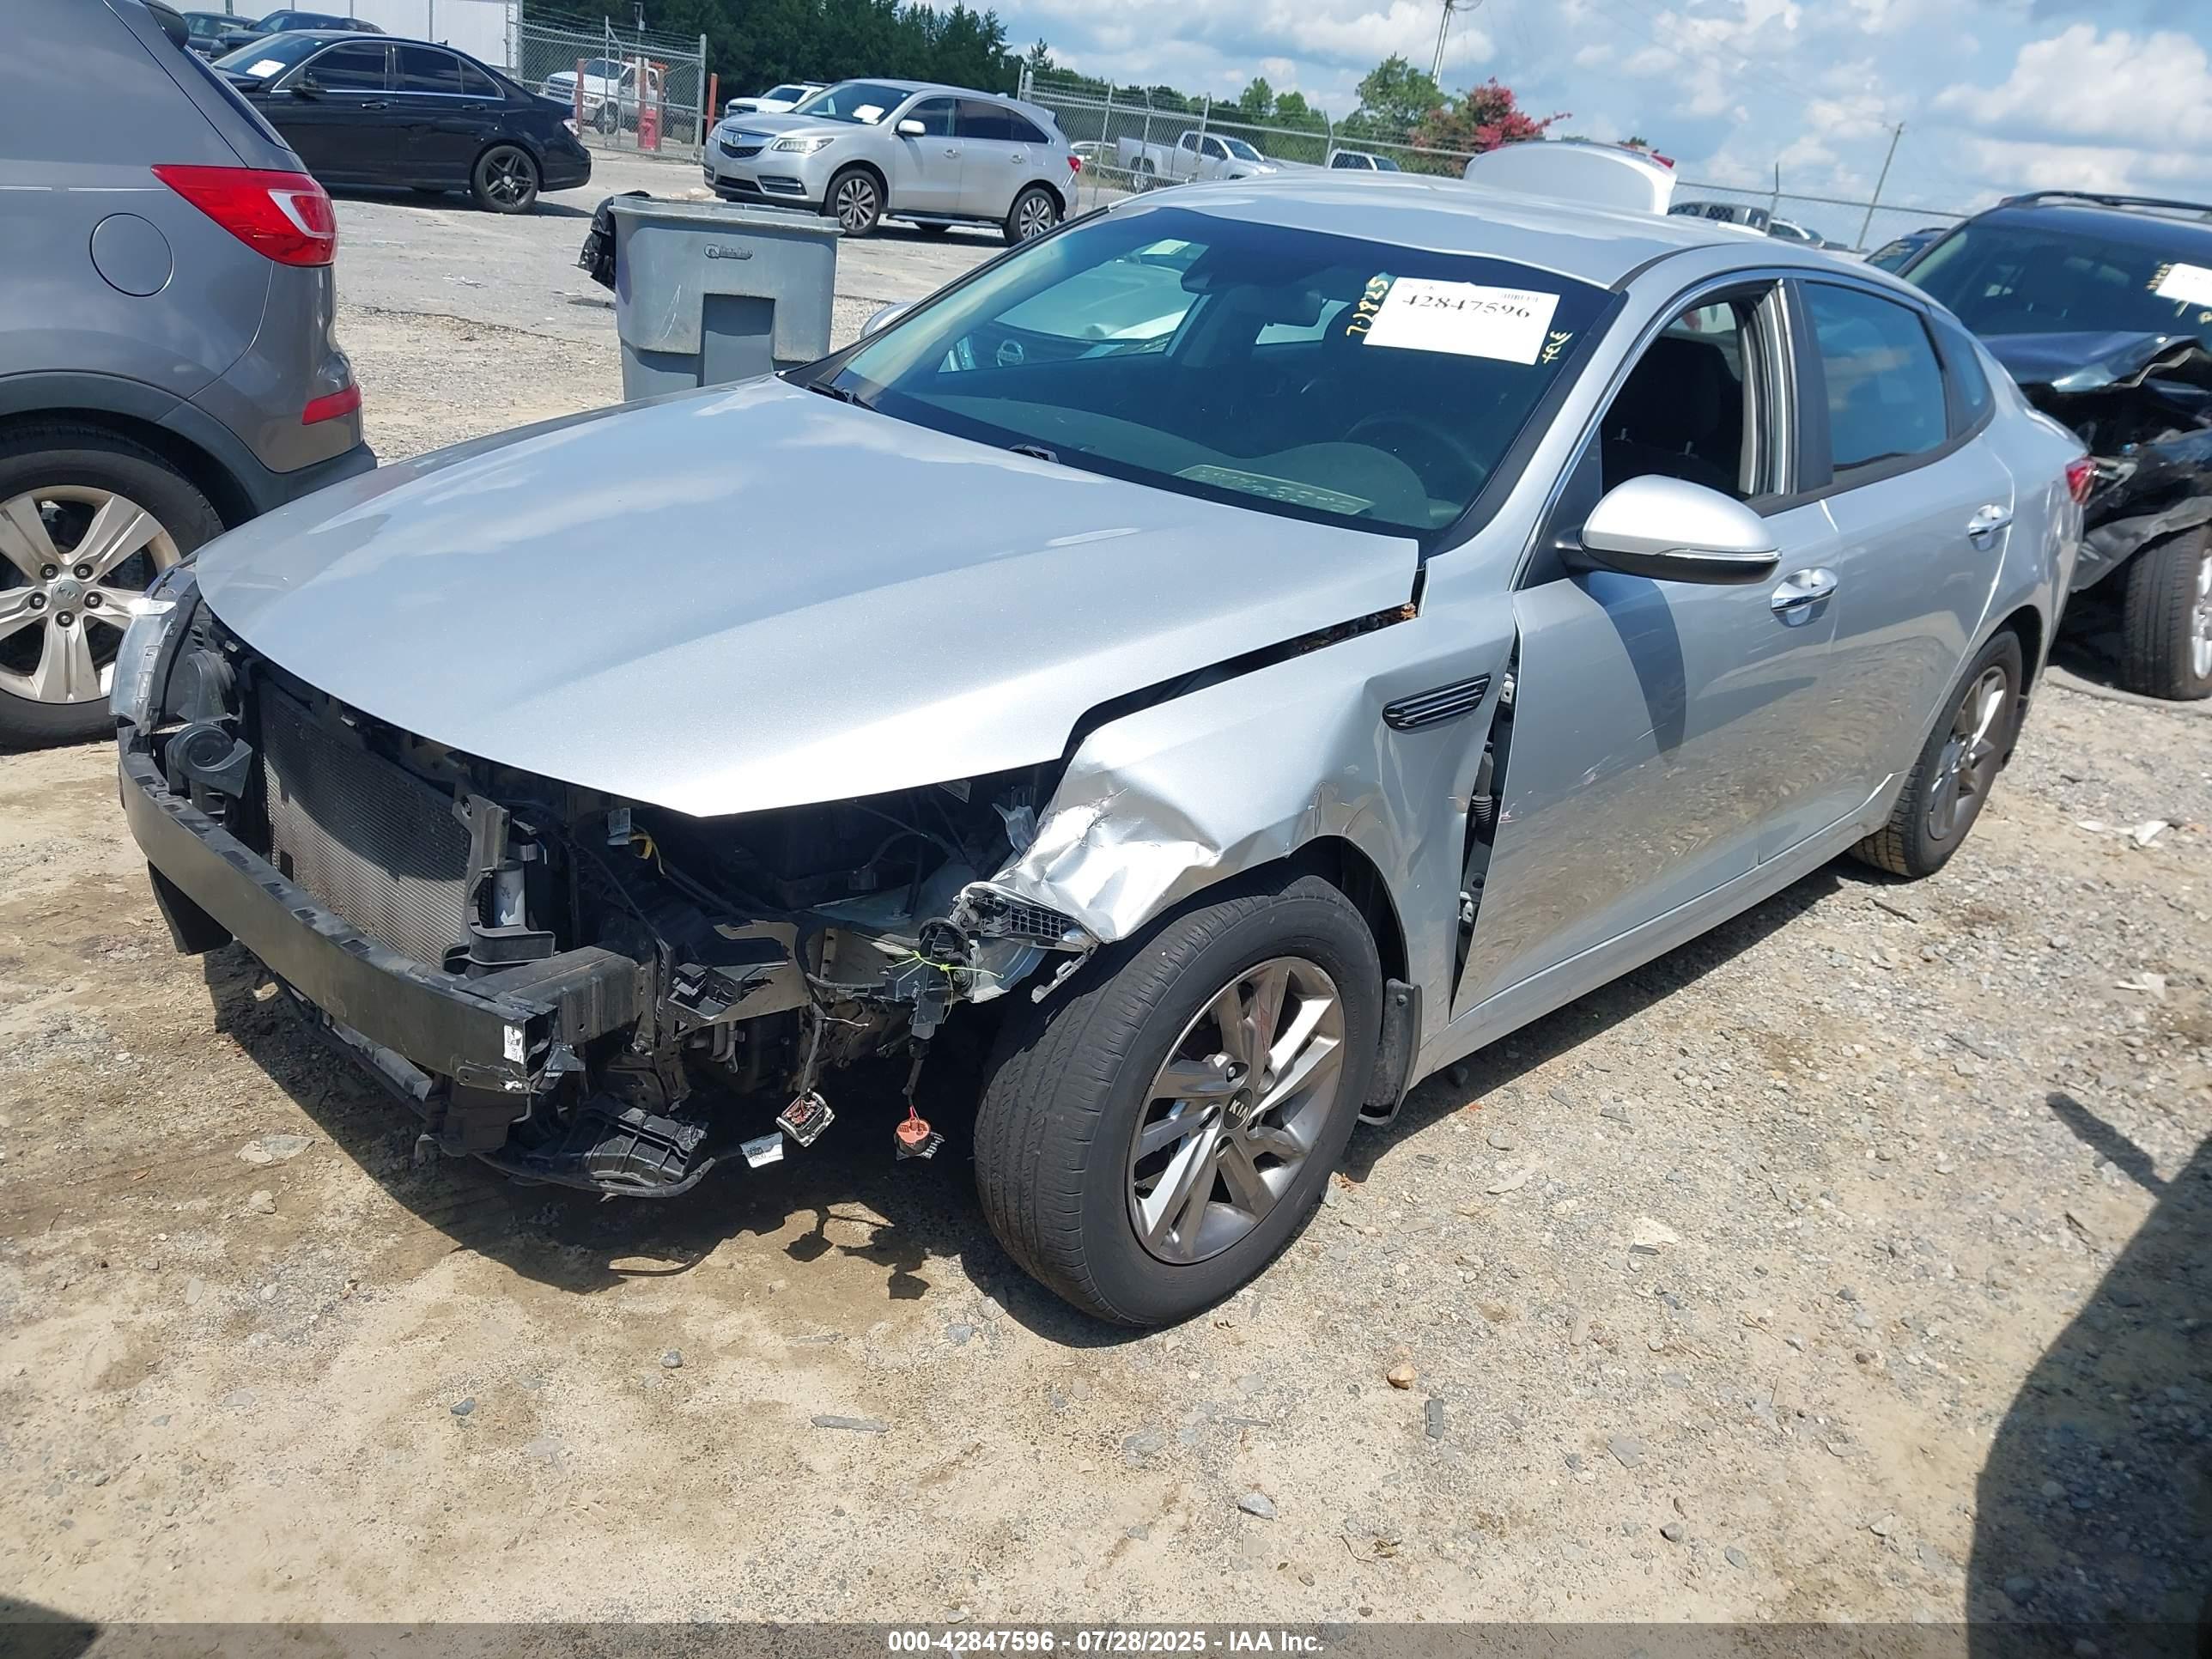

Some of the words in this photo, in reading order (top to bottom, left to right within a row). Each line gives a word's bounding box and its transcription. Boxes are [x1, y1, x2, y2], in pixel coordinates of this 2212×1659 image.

[1401, 294, 1531, 319] 42847596
[56, 586, 77, 599] KIA
[1228, 1098, 1249, 1121] KIA
